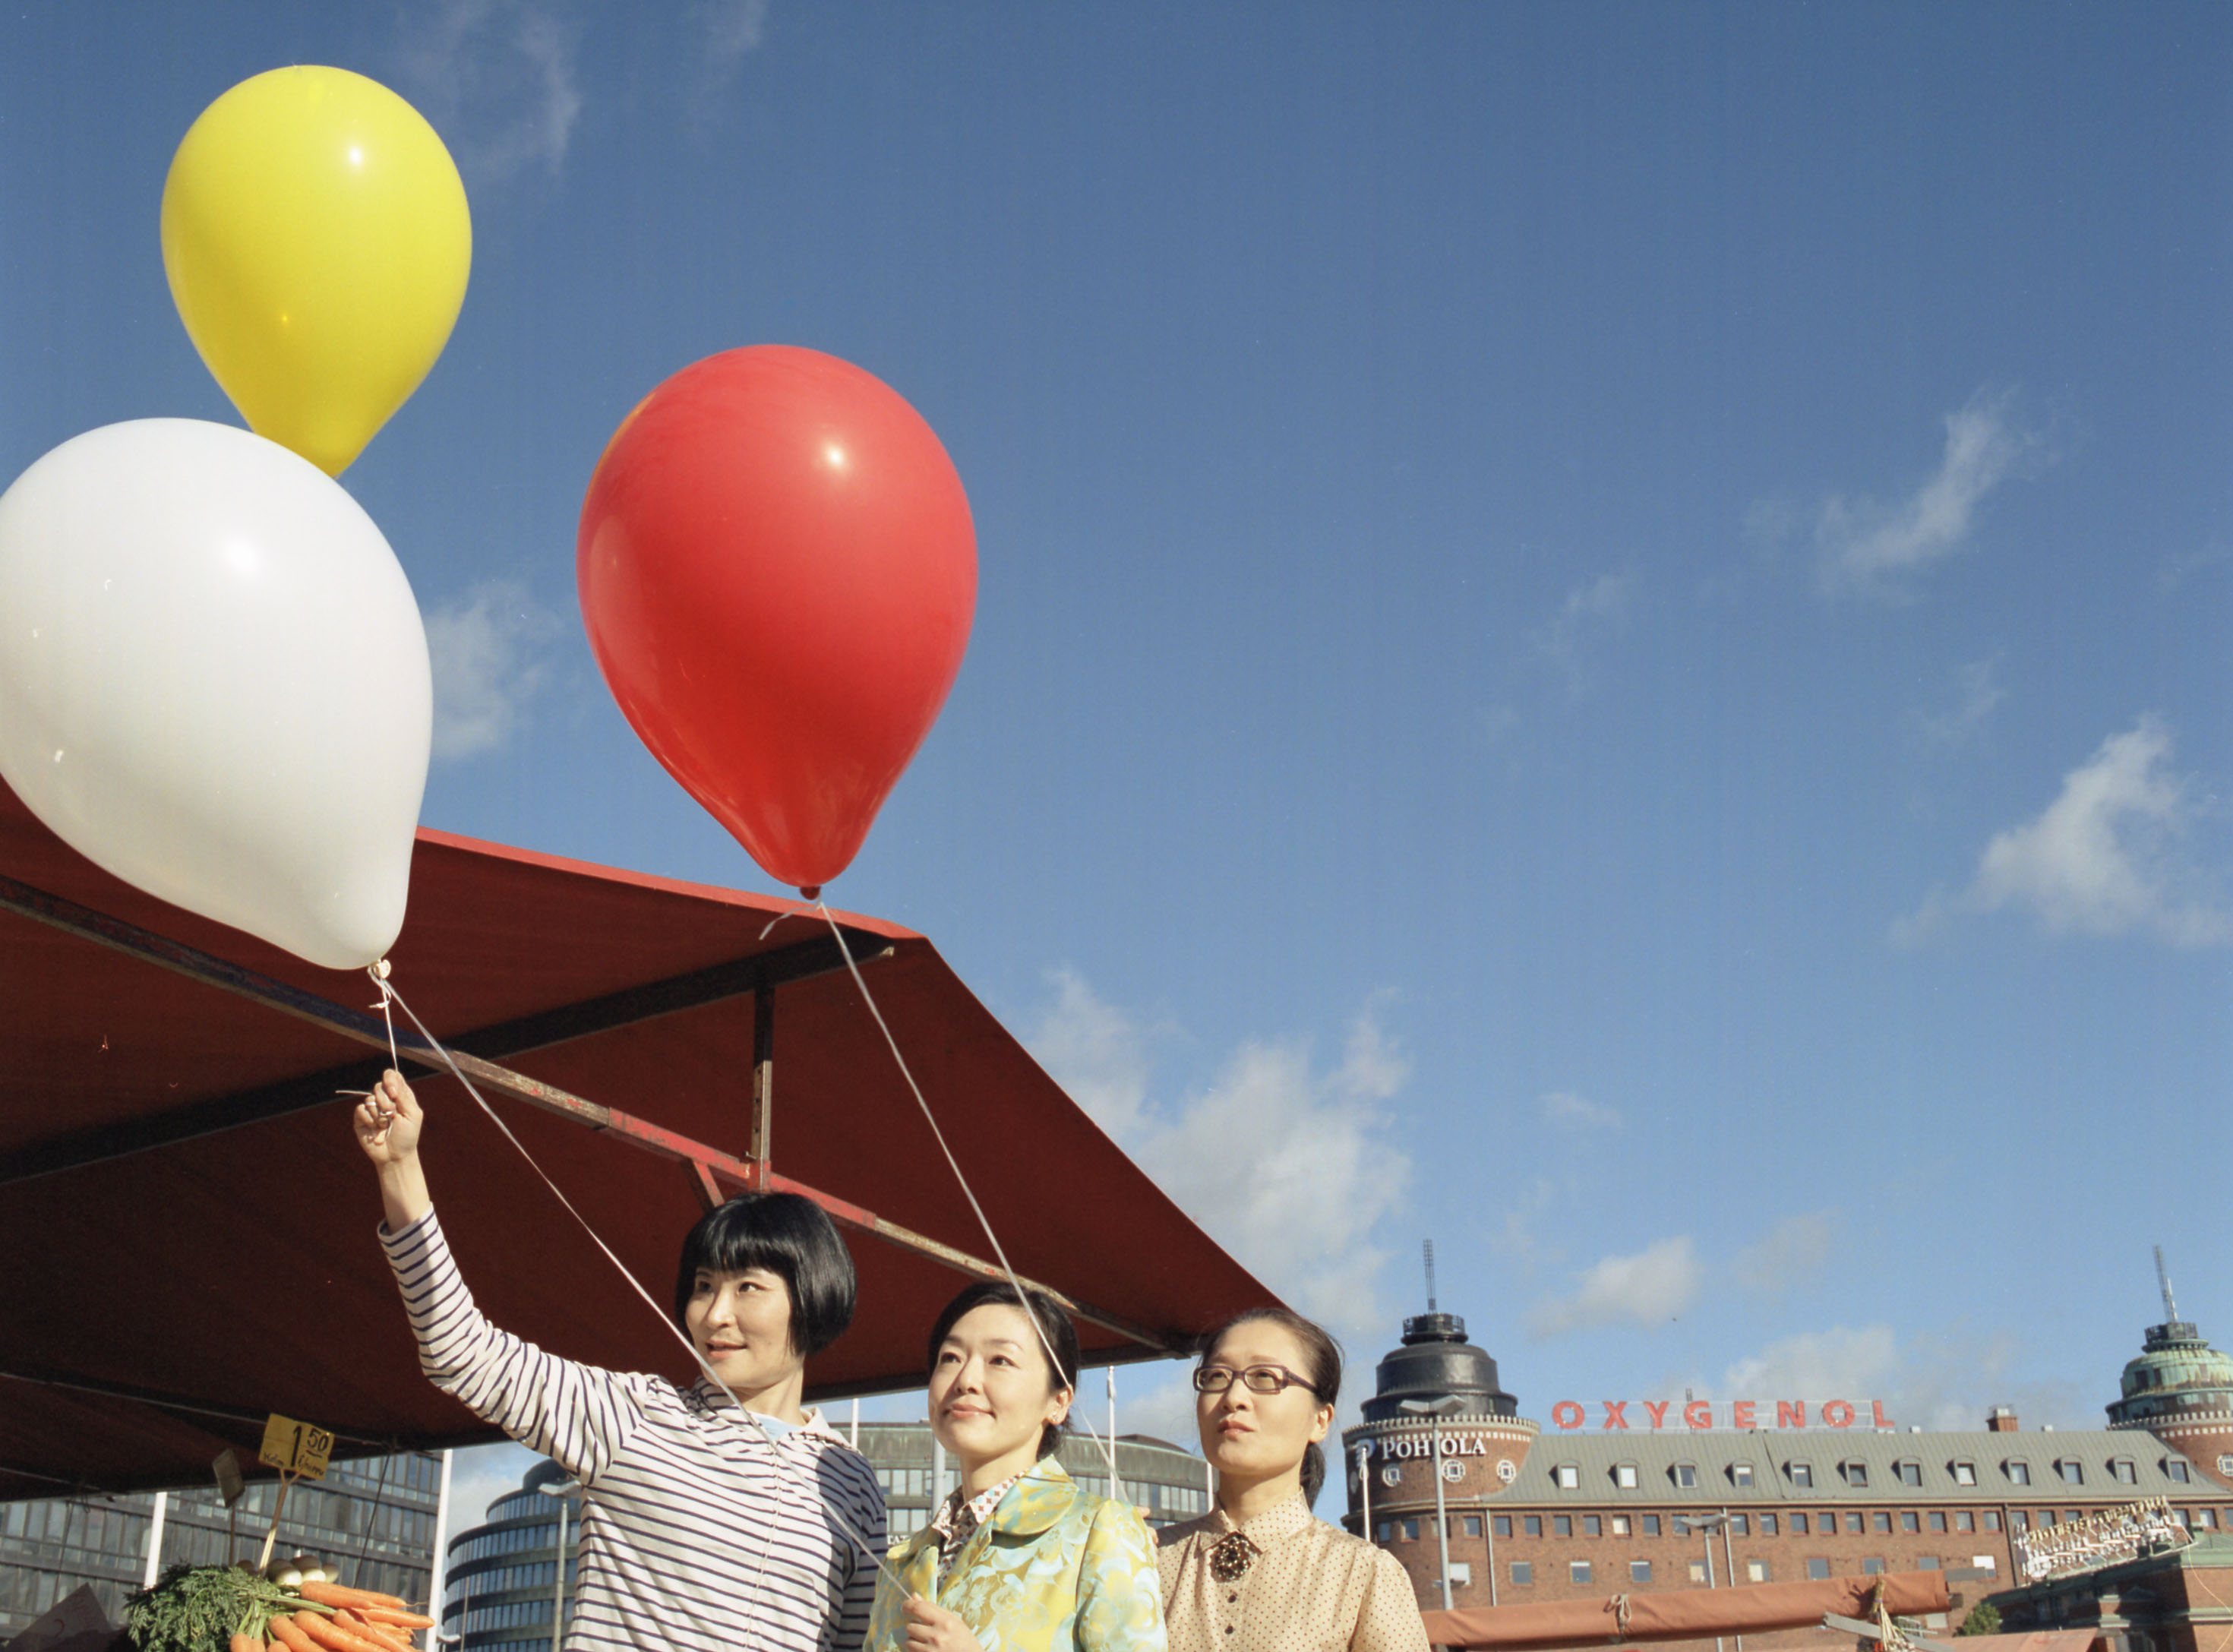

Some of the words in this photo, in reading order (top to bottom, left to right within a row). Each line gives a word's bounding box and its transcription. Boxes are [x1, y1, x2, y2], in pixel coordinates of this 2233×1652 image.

[1552, 1400, 1895, 1429] OXYGENOL
[291, 1425, 302, 1467] 1
[307, 1427, 330, 1452] 50
[1382, 1437, 1486, 1460] POHOLA
